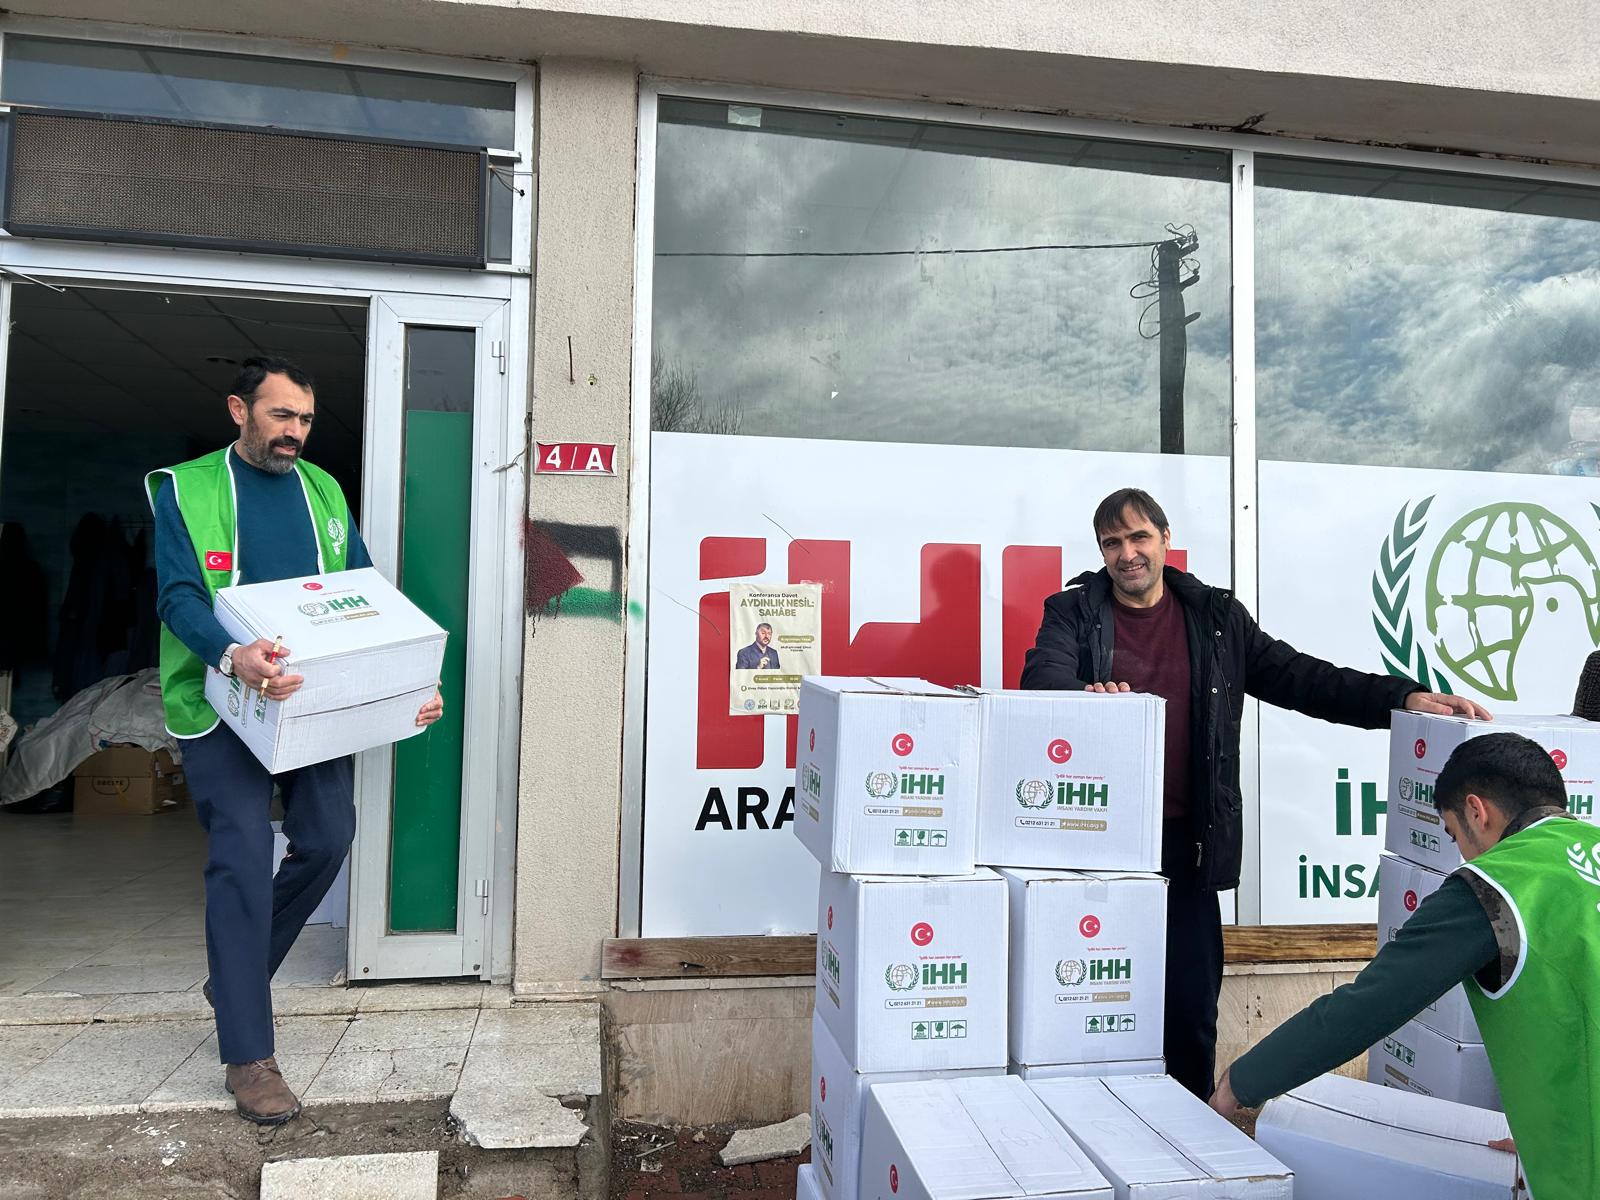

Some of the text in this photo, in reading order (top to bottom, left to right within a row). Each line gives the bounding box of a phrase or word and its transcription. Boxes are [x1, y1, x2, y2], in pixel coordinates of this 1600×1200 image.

[740, 597, 815, 608] AYDINLIK NESİL:
[758, 607, 796, 617] SAHÂBE
[694, 786, 796, 831] ARA
[1567, 794, 1593, 815] HH
